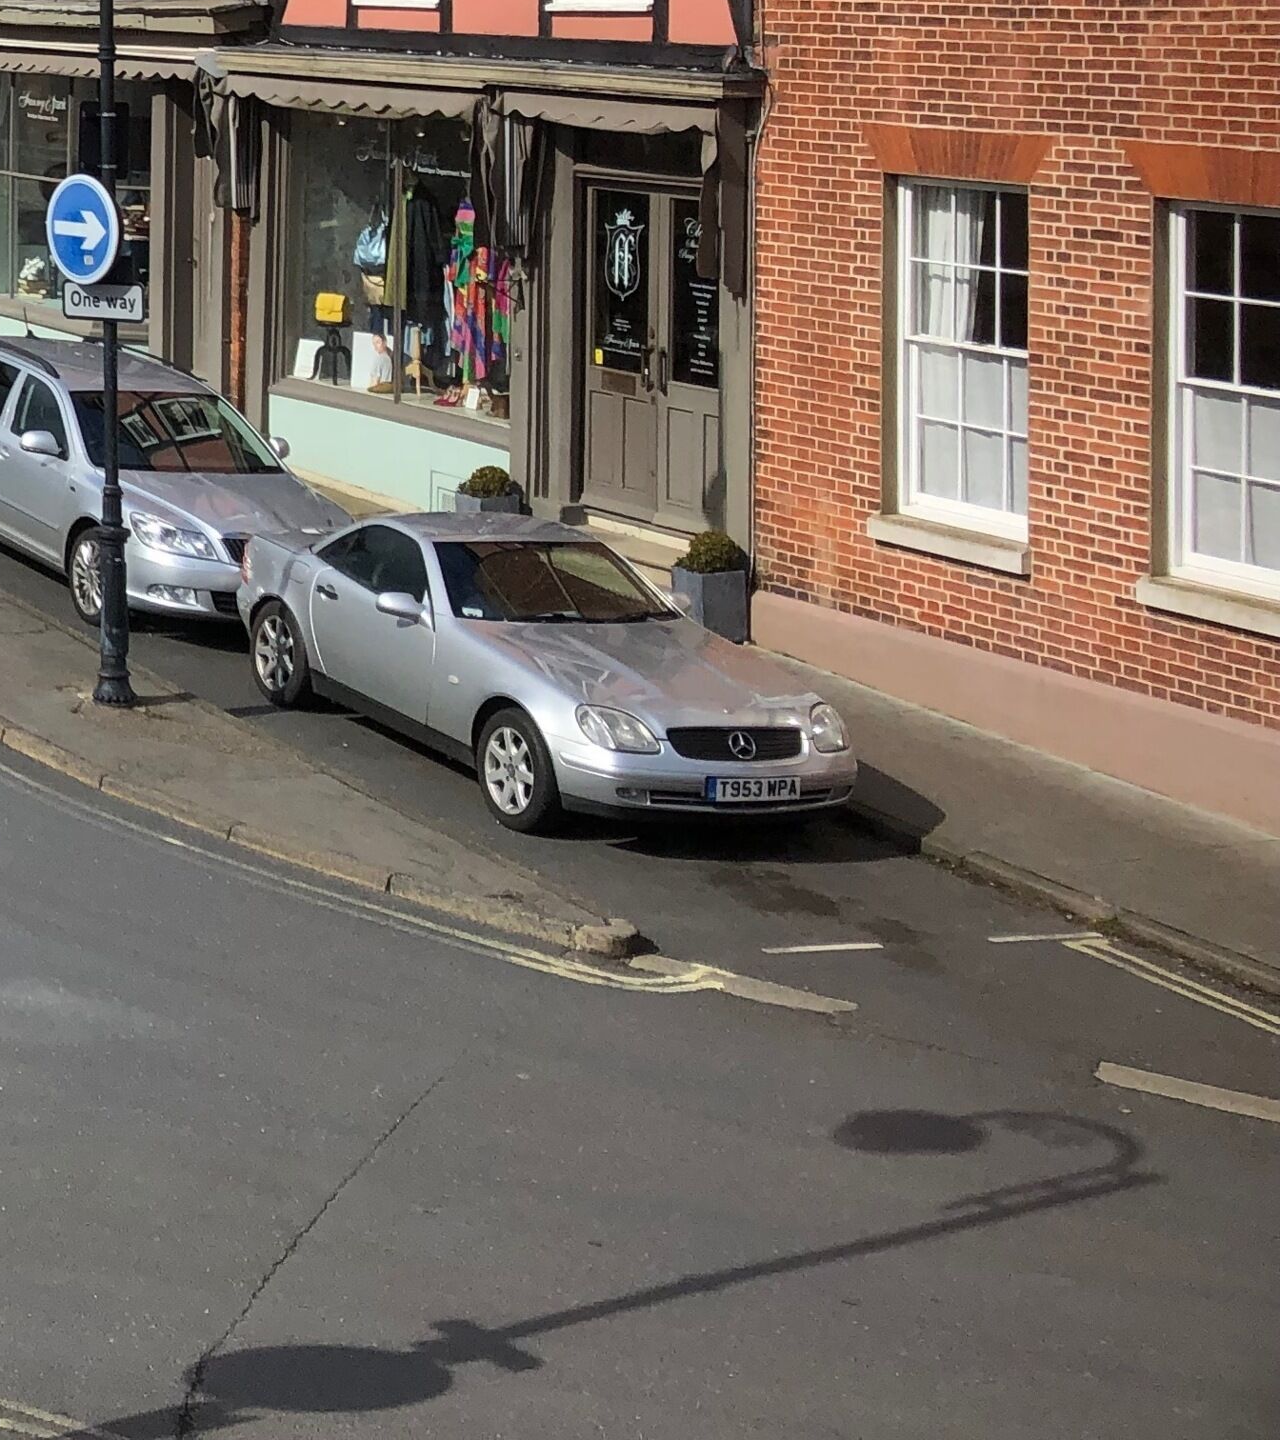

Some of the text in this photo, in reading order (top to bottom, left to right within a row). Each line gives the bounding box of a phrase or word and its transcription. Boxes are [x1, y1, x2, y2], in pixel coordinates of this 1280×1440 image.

[71, 290, 136, 313] One way
[720, 779, 797, 798] T953 WPA
